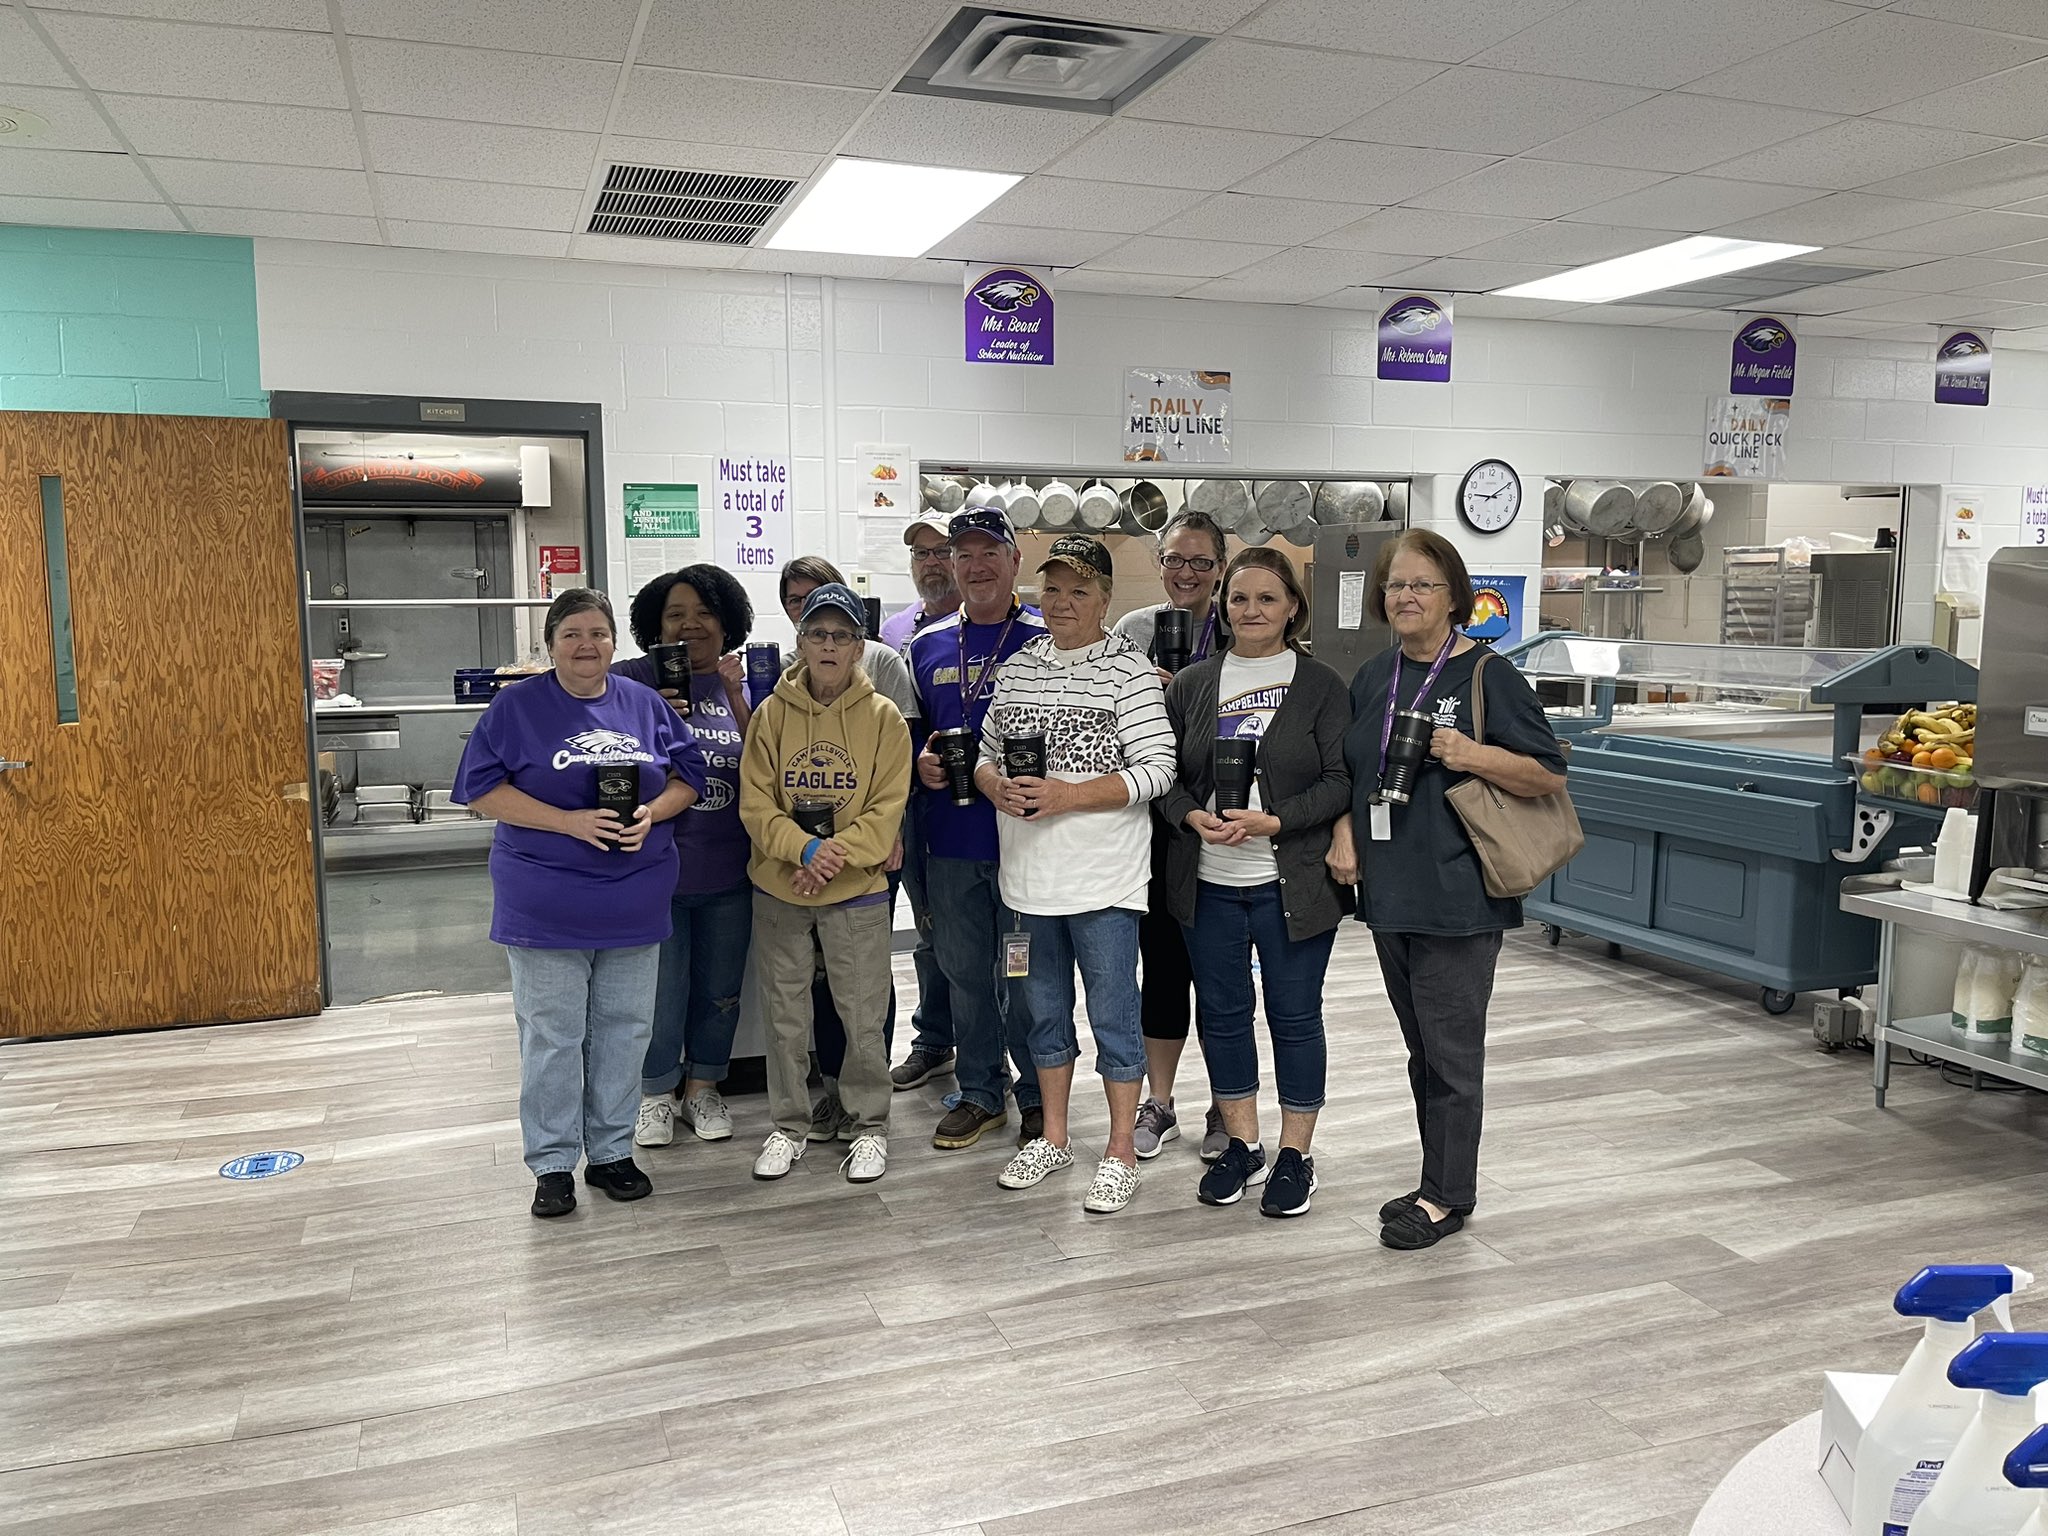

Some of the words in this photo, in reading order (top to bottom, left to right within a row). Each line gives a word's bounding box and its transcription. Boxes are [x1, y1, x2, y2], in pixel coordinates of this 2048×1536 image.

[980, 315, 1005, 332] Mrs.
[1007, 315, 1041, 333] Beard
[990, 338, 1018, 350] Leader
[1019, 340, 1030, 353] of
[977, 348, 1007, 360] School
[1006, 350, 1044, 362] Nutrition
[1381, 346, 1397, 362] Mrs.
[1398, 346, 1424, 363] Rebecca
[1425, 348, 1447, 365] Carter
[1733, 363, 1746, 377] Ms.
[1747, 363, 1771, 383] Megan
[1770, 364, 1793, 379] Fields
[1150, 397, 1204, 416] DAILY
[1130, 416, 1180, 434] MENU
[1186, 417, 1223, 435] LINE
[1731, 418, 1767, 432] DAILY
[1709, 431, 1749, 446] QUICK
[1752, 433, 1782, 446] PICK
[1734, 446, 1759, 459] LINE
[720, 458, 752, 482] Must
[756, 459, 786, 483] take
[1479, 471, 1485, 480] 11
[1489, 468, 1496, 477] 12
[325, 466, 412, 489] OVERHEAD
[417, 468, 463, 491] DOOR
[1470, 480, 1478, 490] 10
[723, 492, 731, 510] a
[735, 488, 767, 512] total
[771, 489, 785, 512] of
[1467, 493, 1473, 501] 9
[1508, 494, 1513, 502] 3
[2026, 487, 2043, 504] Must
[1469, 504, 1475, 513] 8
[1503, 505, 1509, 513] 4
[1475, 514, 1481, 524] 7
[1485, 517, 1491, 525] 6
[1496, 514, 1502, 523] 5
[2026, 511, 2031, 525] a
[746, 515, 763, 538] 3
[2035, 528, 2046, 545] 3
[737, 541, 774, 565] items
[1056, 543, 1087, 551] SLEEP
[1159, 625, 1186, 635] Megan
[699, 701, 728, 717] No
[552, 749, 654, 770] Campbellsville
[700, 750, 739, 769] Yes
[791, 744, 852, 768] CAMBELLSVILLE
[784, 770, 857, 790] EAGLES
